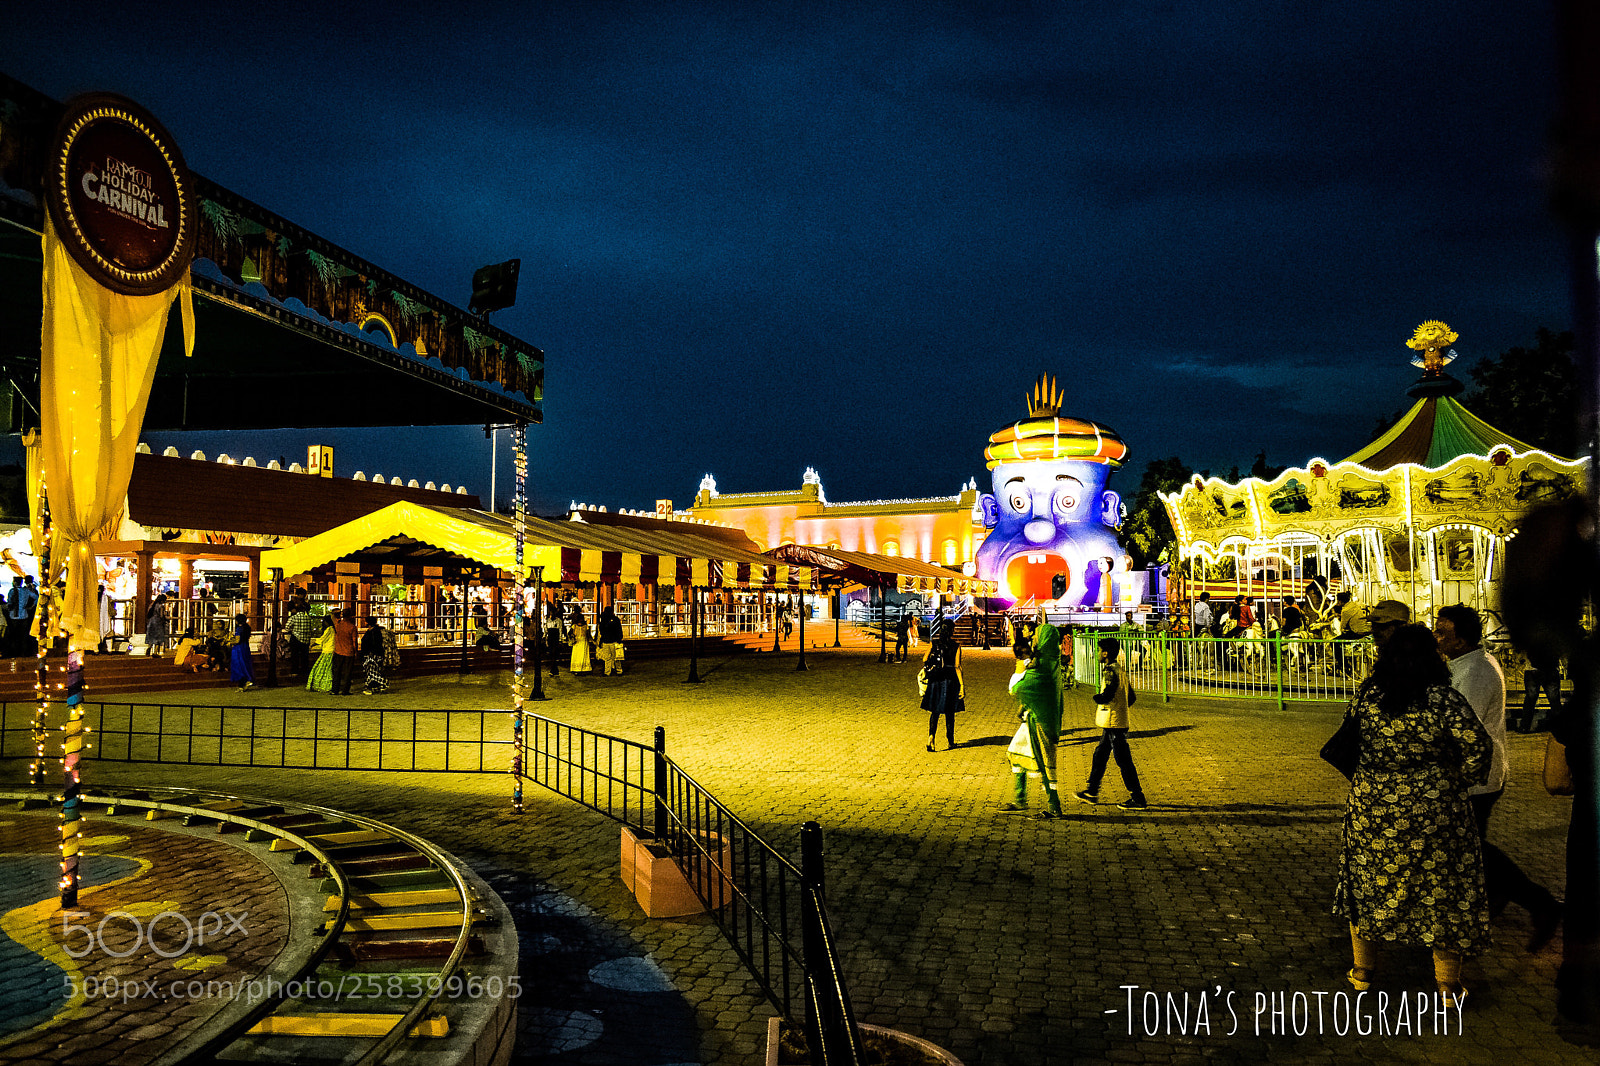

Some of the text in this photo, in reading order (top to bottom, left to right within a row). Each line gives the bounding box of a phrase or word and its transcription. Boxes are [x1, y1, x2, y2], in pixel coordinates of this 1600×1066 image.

[105, 156, 152, 190] RAMOJI
[101, 170, 155, 203] HOLIDAY
[82, 172, 169, 229] CARNIVAL
[311, 452, 318, 468] 1
[323, 453, 330, 470] 1
[658, 504, 665, 514] 2
[667, 505, 672, 514] 2
